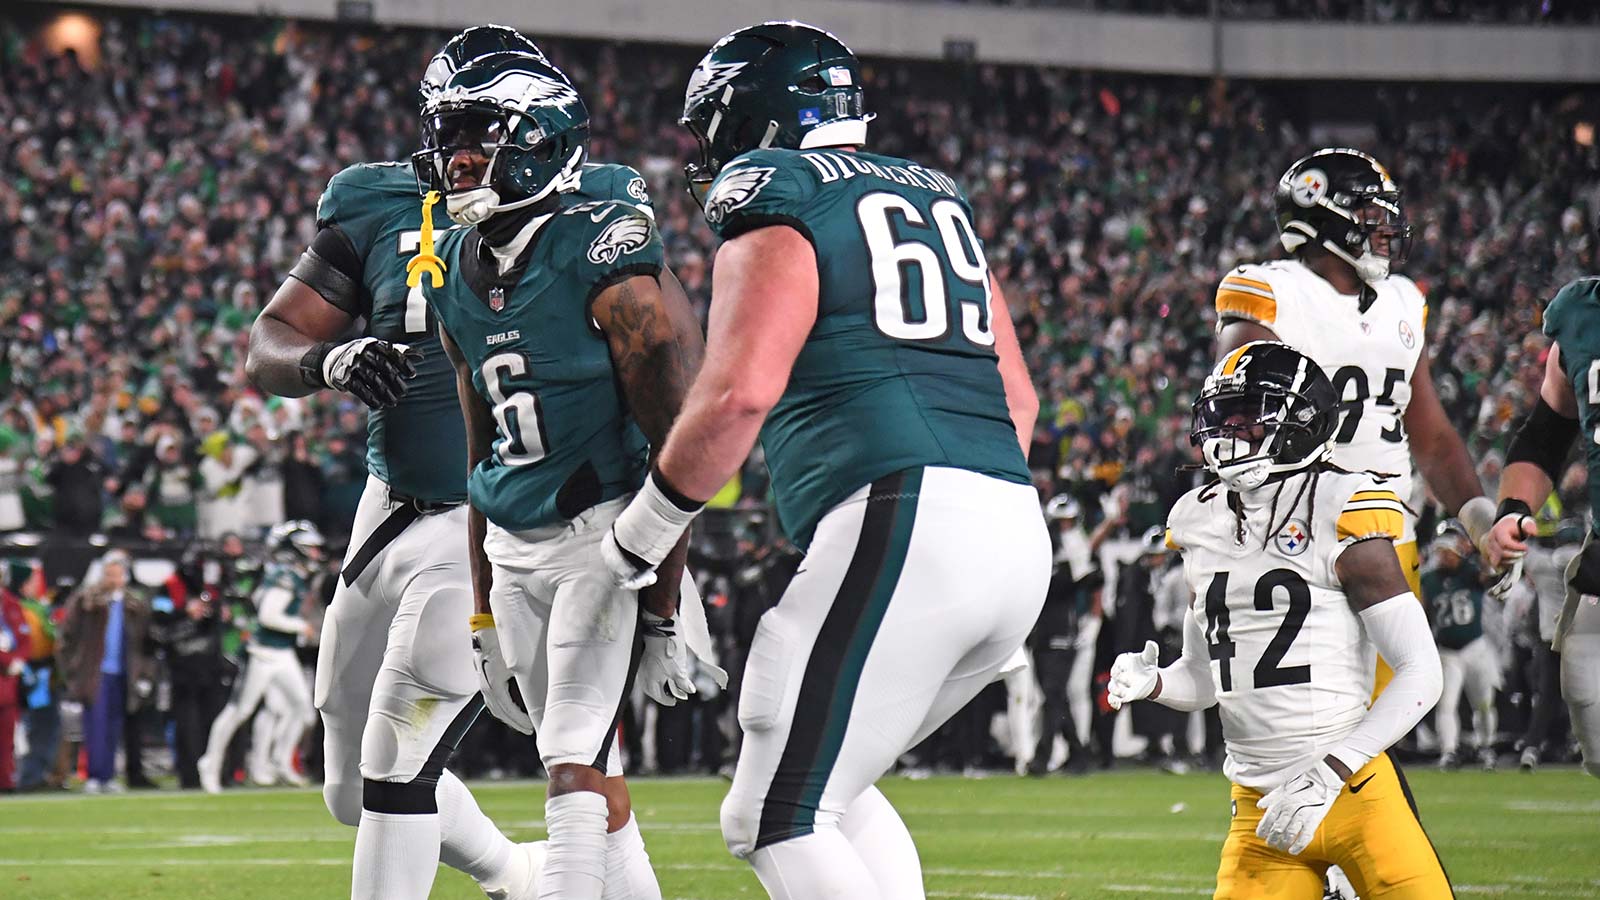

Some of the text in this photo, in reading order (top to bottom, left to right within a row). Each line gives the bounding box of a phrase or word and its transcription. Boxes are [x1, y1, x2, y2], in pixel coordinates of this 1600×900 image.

[856, 192, 996, 346] 69
[486, 329, 521, 345] EAGLES
[481, 352, 546, 466] 6
[1332, 365, 1406, 444] 95
[1205, 567, 1312, 692] 42
[1432, 588, 1475, 628] 26
